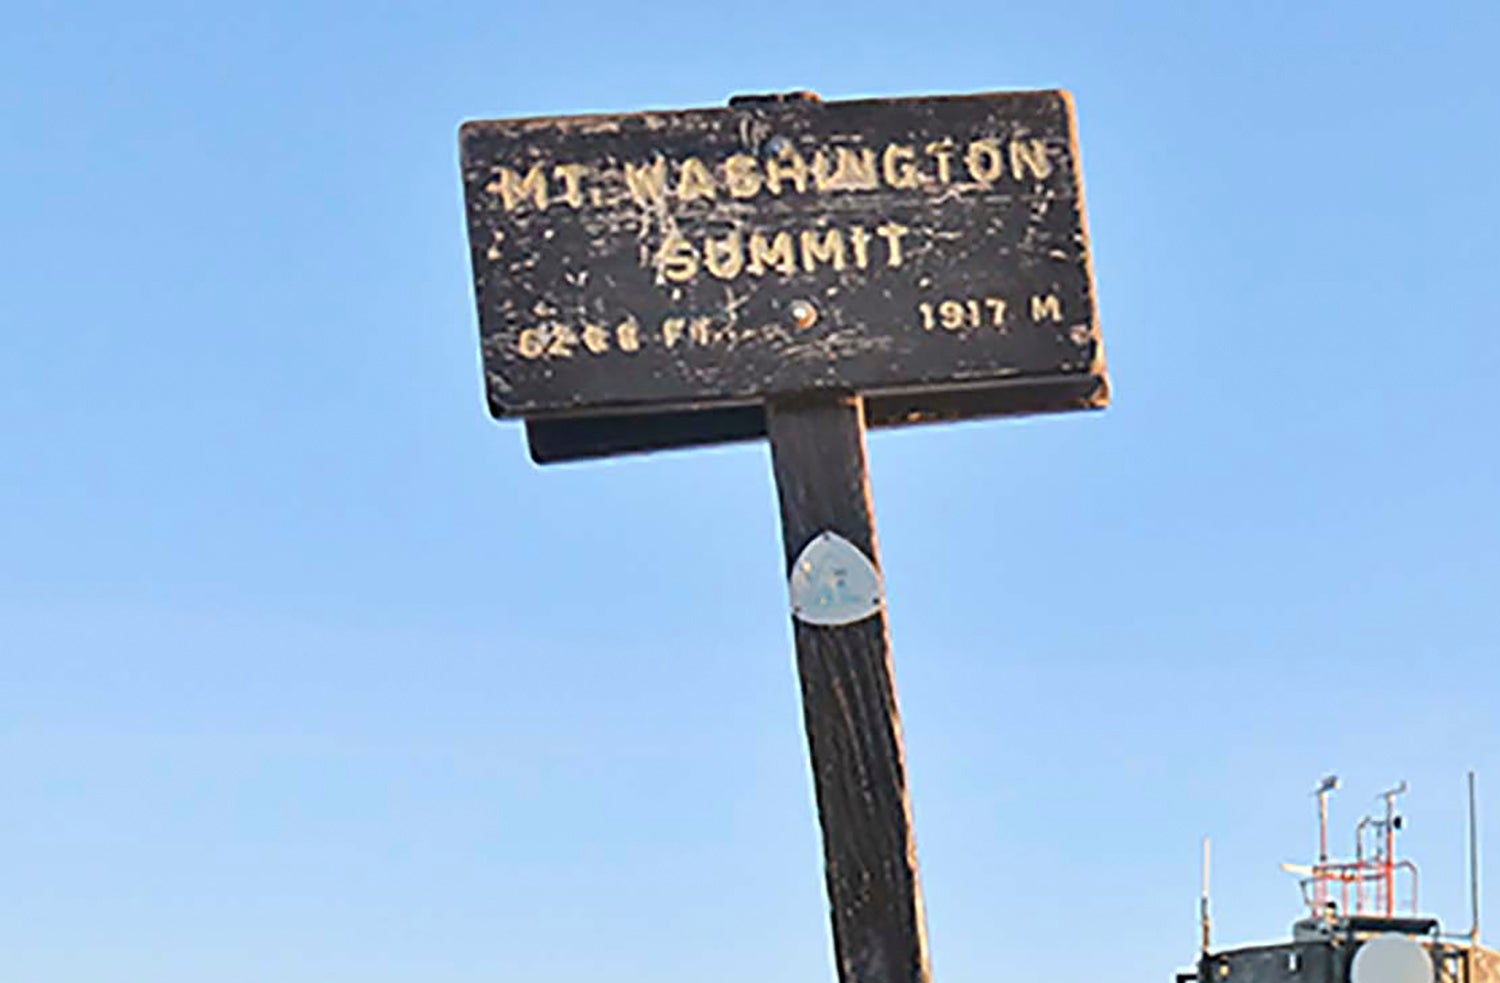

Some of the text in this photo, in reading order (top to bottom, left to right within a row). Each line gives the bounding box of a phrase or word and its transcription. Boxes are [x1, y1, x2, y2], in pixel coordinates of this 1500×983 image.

[624, 139, 1051, 208] WASHINGTON
[660, 224, 908, 281] SUMMIT
[919, 294, 1062, 330] 1917 M
